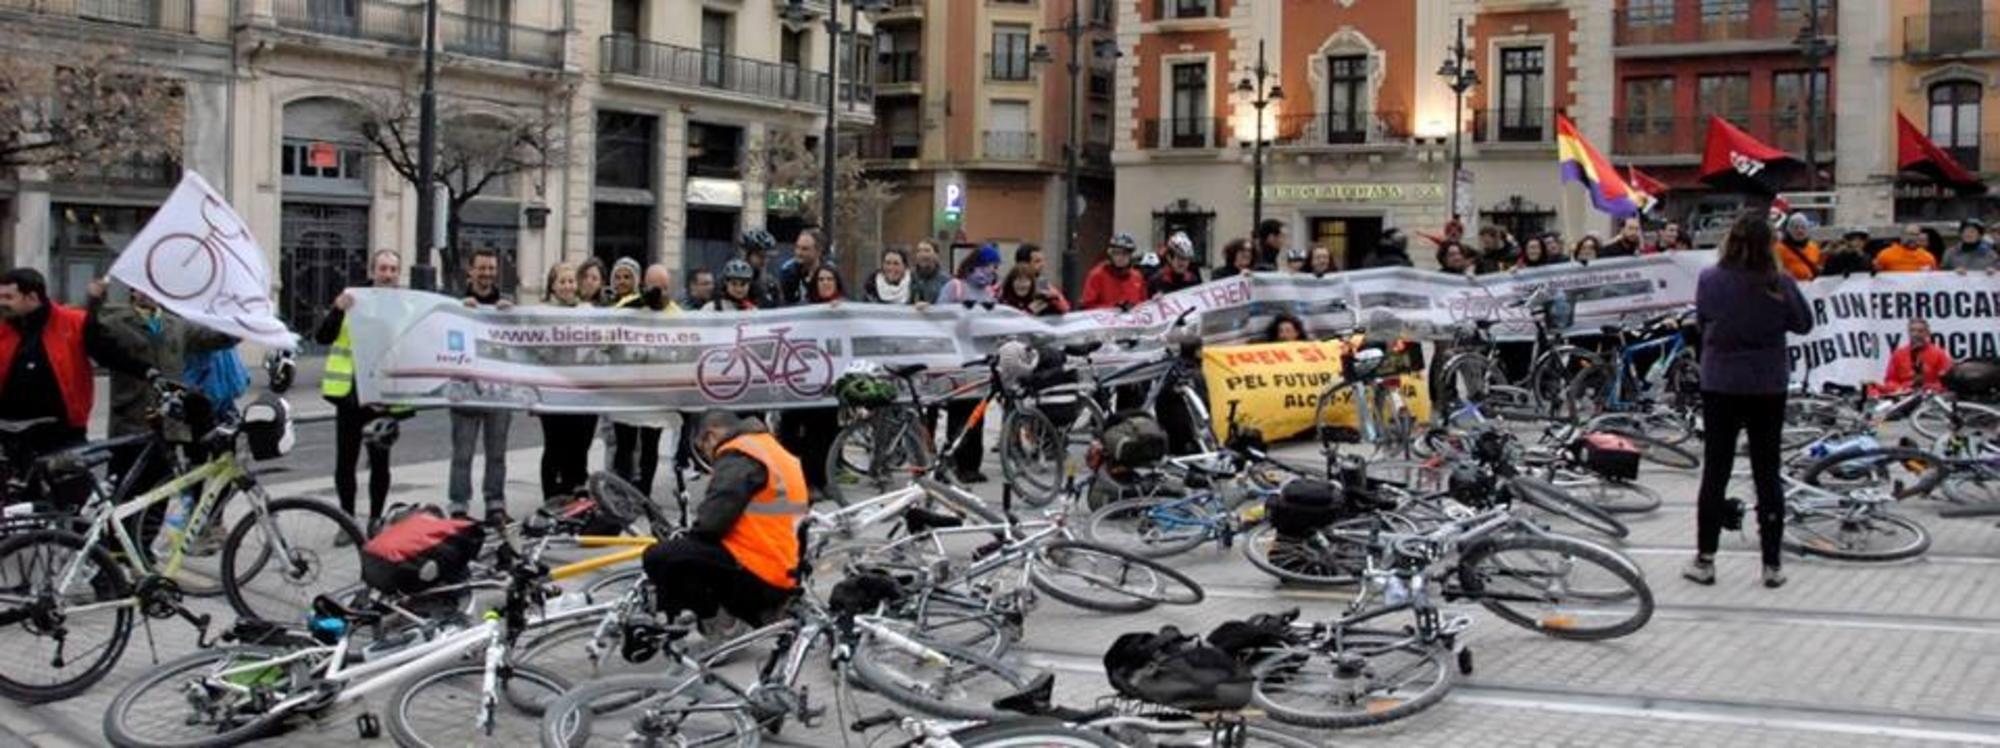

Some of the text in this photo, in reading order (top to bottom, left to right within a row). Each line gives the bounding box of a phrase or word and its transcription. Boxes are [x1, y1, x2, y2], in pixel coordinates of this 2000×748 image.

[946, 184, 959, 208] P
[1193, 279, 1251, 310] TREN
[1829, 293, 1867, 319] UN
[1929, 332, 2000, 360] OCIA
[1226, 372, 1332, 390] PEL FUTUR
